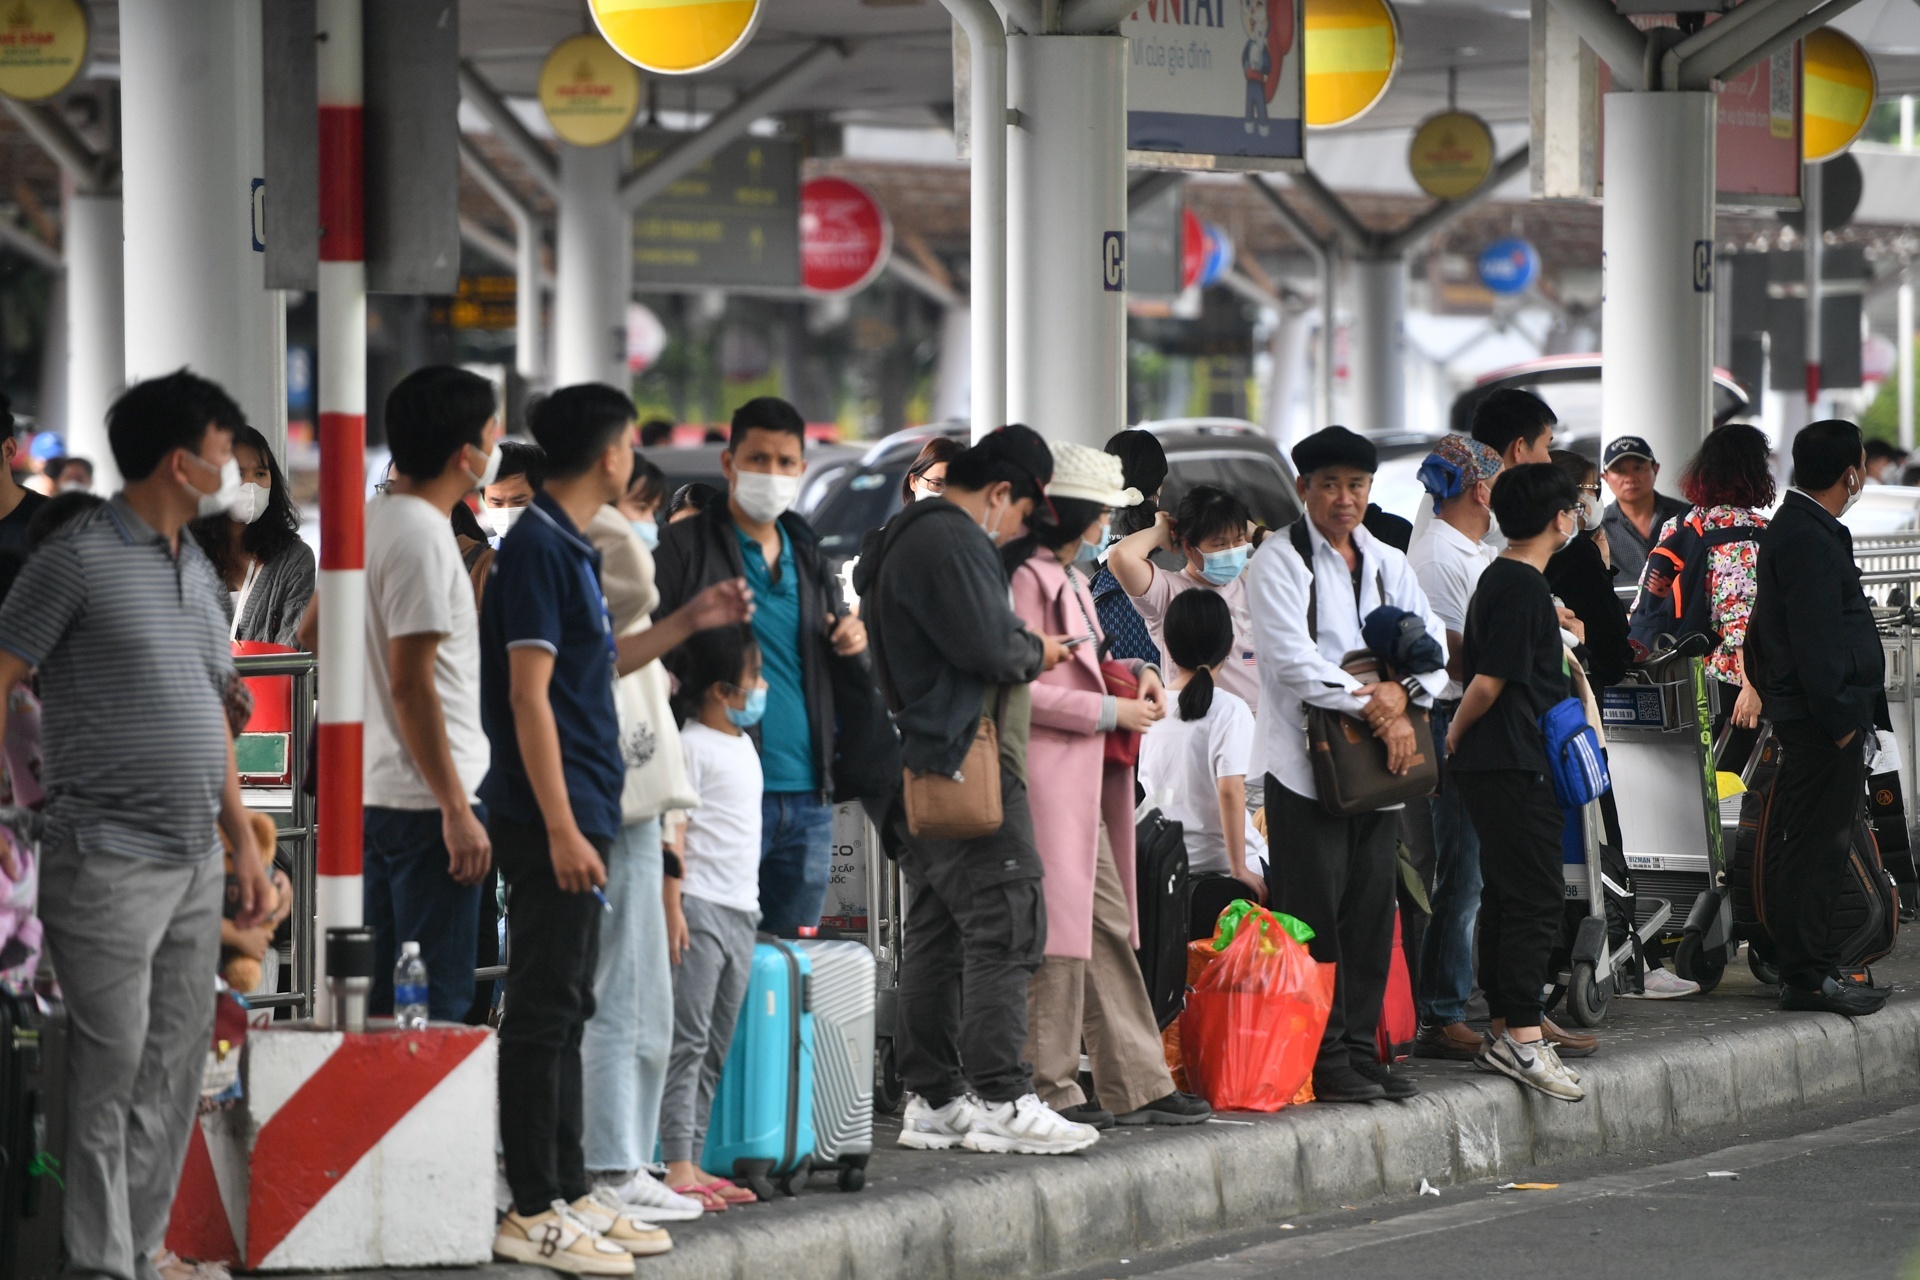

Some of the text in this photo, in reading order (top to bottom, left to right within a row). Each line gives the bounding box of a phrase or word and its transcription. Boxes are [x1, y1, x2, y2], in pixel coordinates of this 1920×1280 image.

[1168, 39, 1185, 76] gia
[838, 863, 854, 873] CẤP
[1563, 884, 1578, 896] 98
[538, 1223, 562, 1258] B
